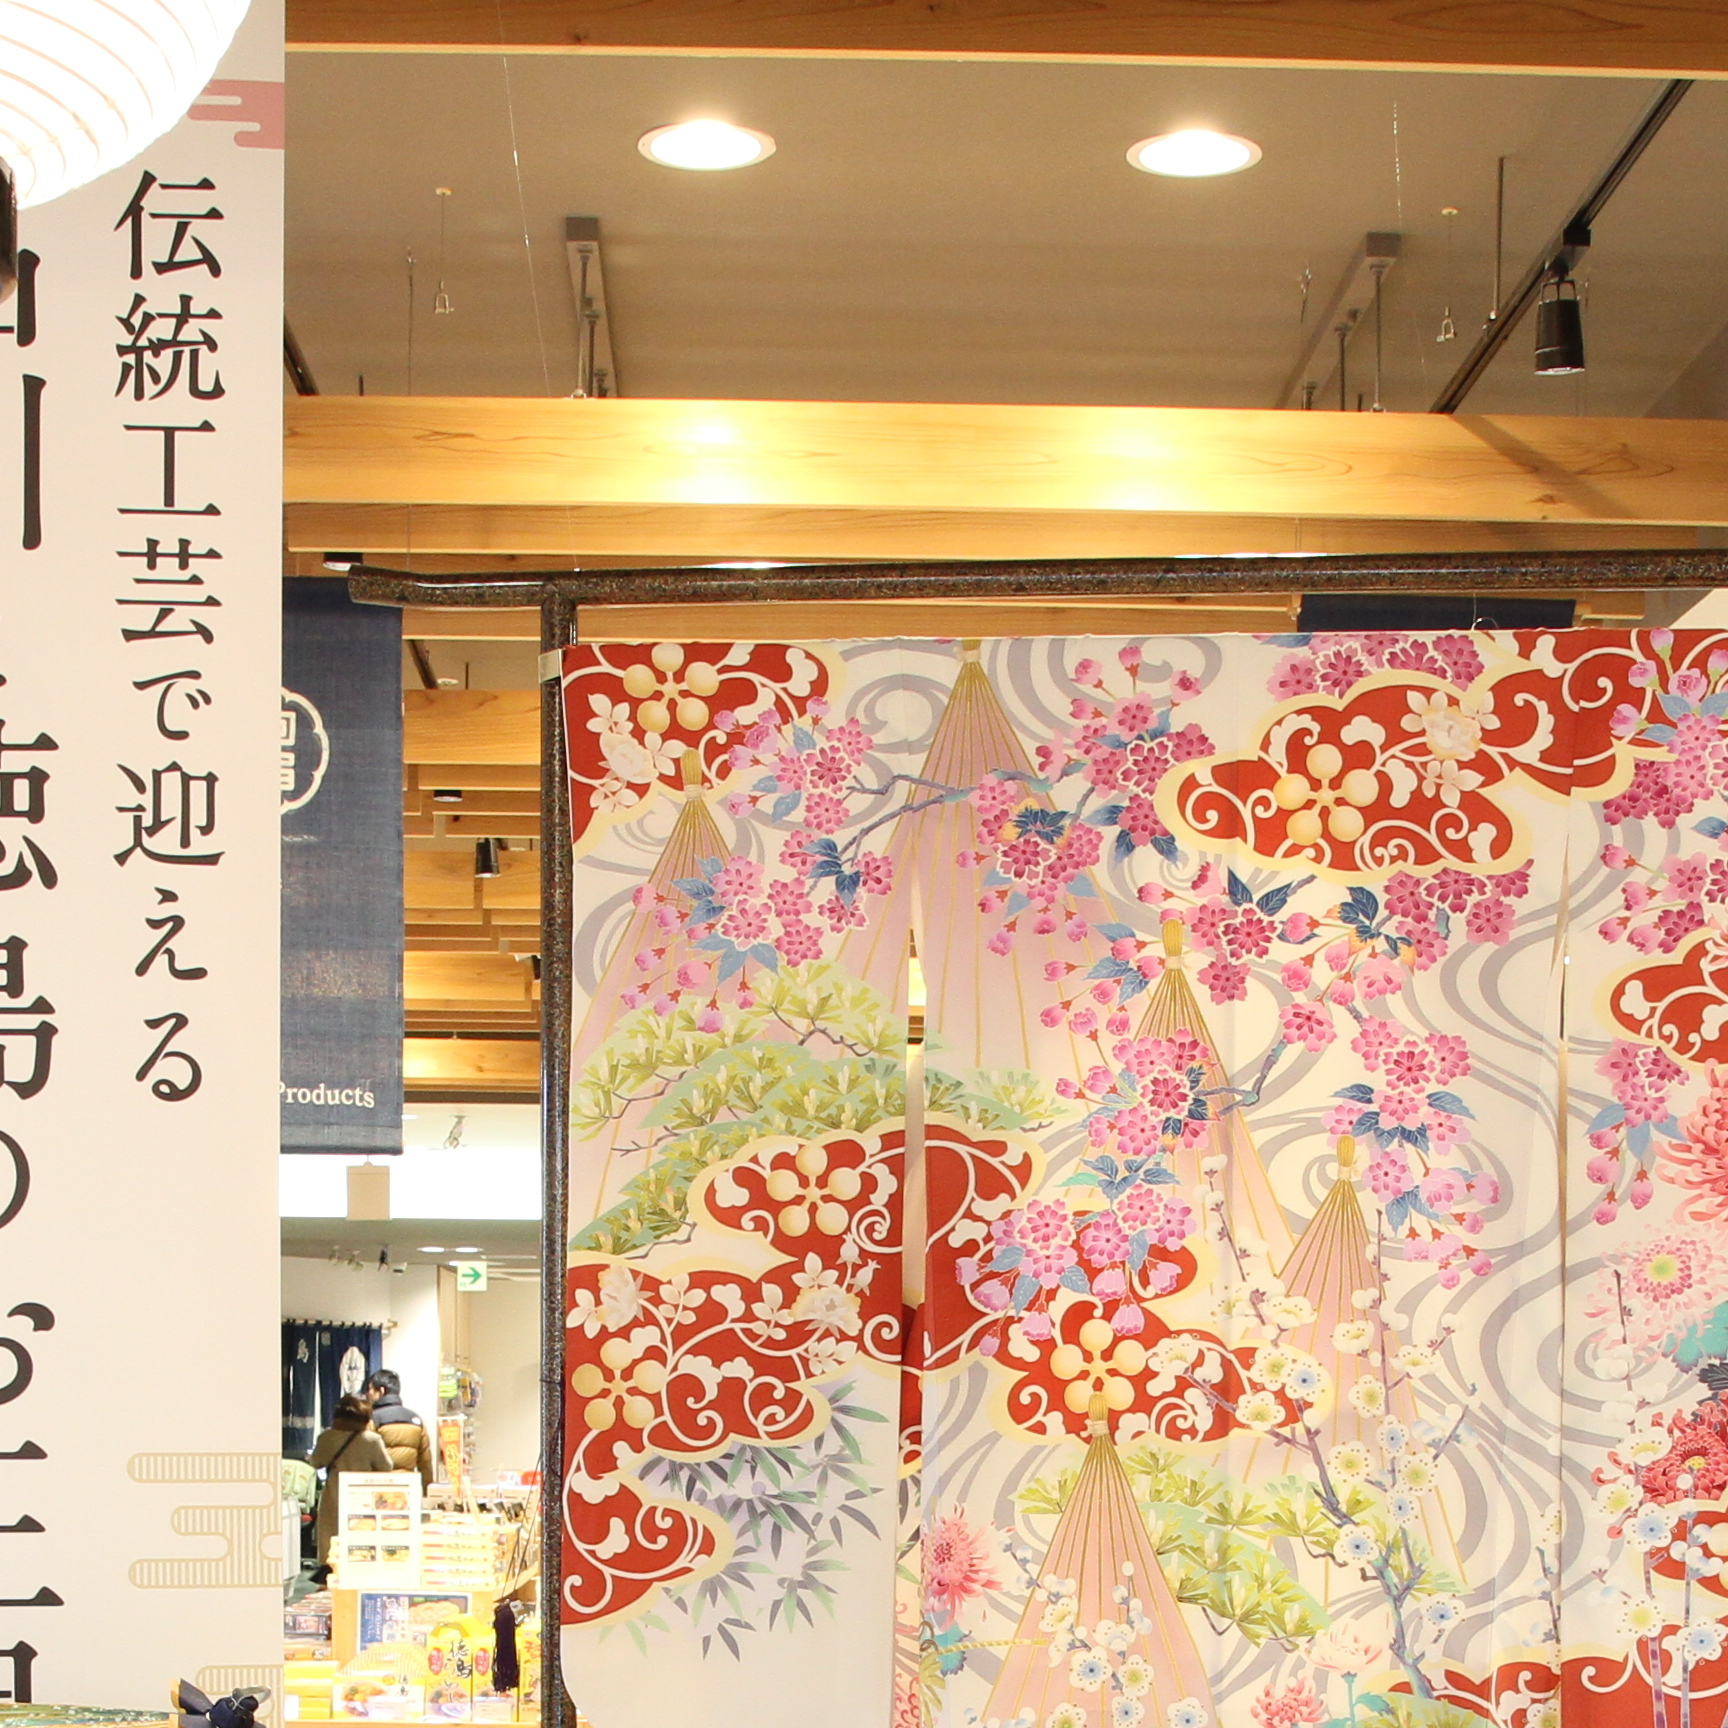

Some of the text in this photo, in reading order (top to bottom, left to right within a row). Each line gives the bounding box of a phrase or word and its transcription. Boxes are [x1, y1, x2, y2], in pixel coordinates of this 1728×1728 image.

[113, 170, 226, 1102] 伝統工芸で迎える
